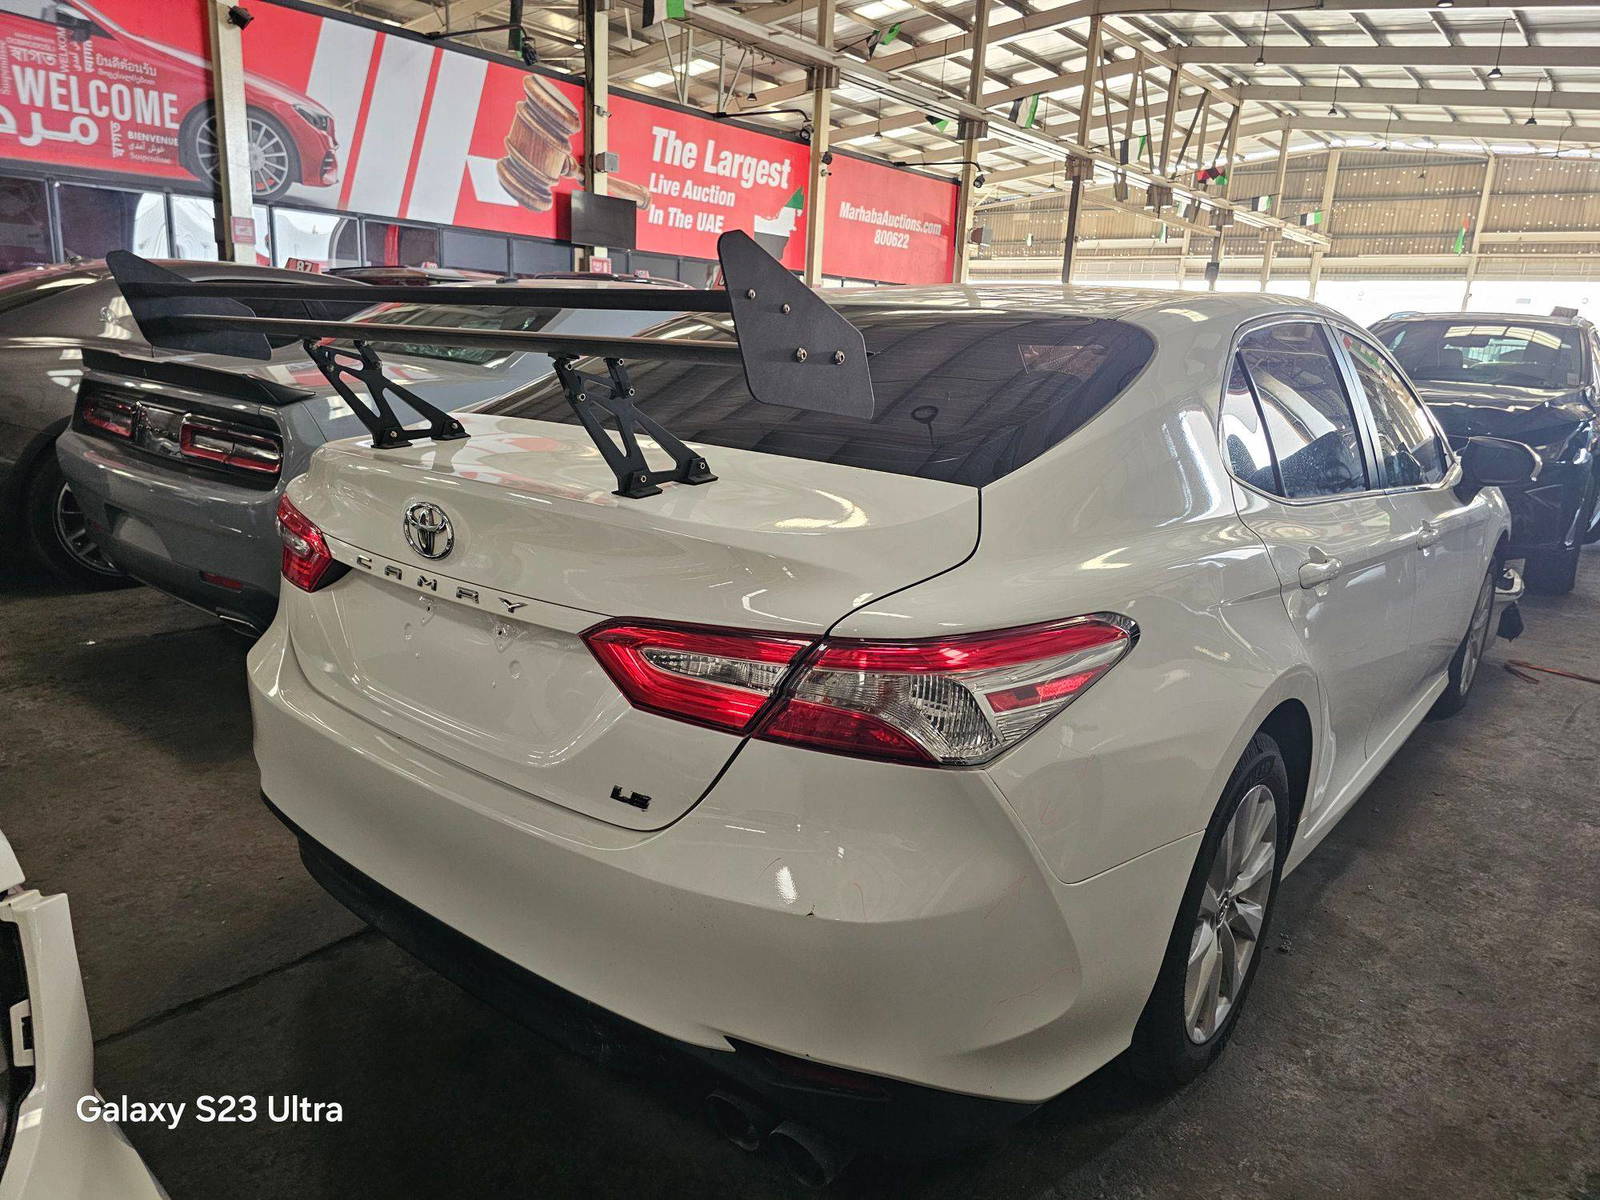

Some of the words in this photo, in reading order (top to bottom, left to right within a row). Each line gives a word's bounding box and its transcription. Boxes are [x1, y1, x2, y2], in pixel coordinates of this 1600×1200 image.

[12, 65, 180, 129] WELCOME
[127, 131, 179, 147] BIENVENUE
[652, 126, 698, 169] The
[703, 139, 791, 189] Largest
[649, 172, 680, 197] Live
[682, 180, 736, 207] Auction
[648, 204, 664, 225] In
[668, 207, 693, 229] The
[696, 212, 725, 234] UAE
[840, 201, 942, 236] MarhabaAuctions.com
[874, 229, 910, 249] 800622
[356, 554, 528, 613] CAMRY
